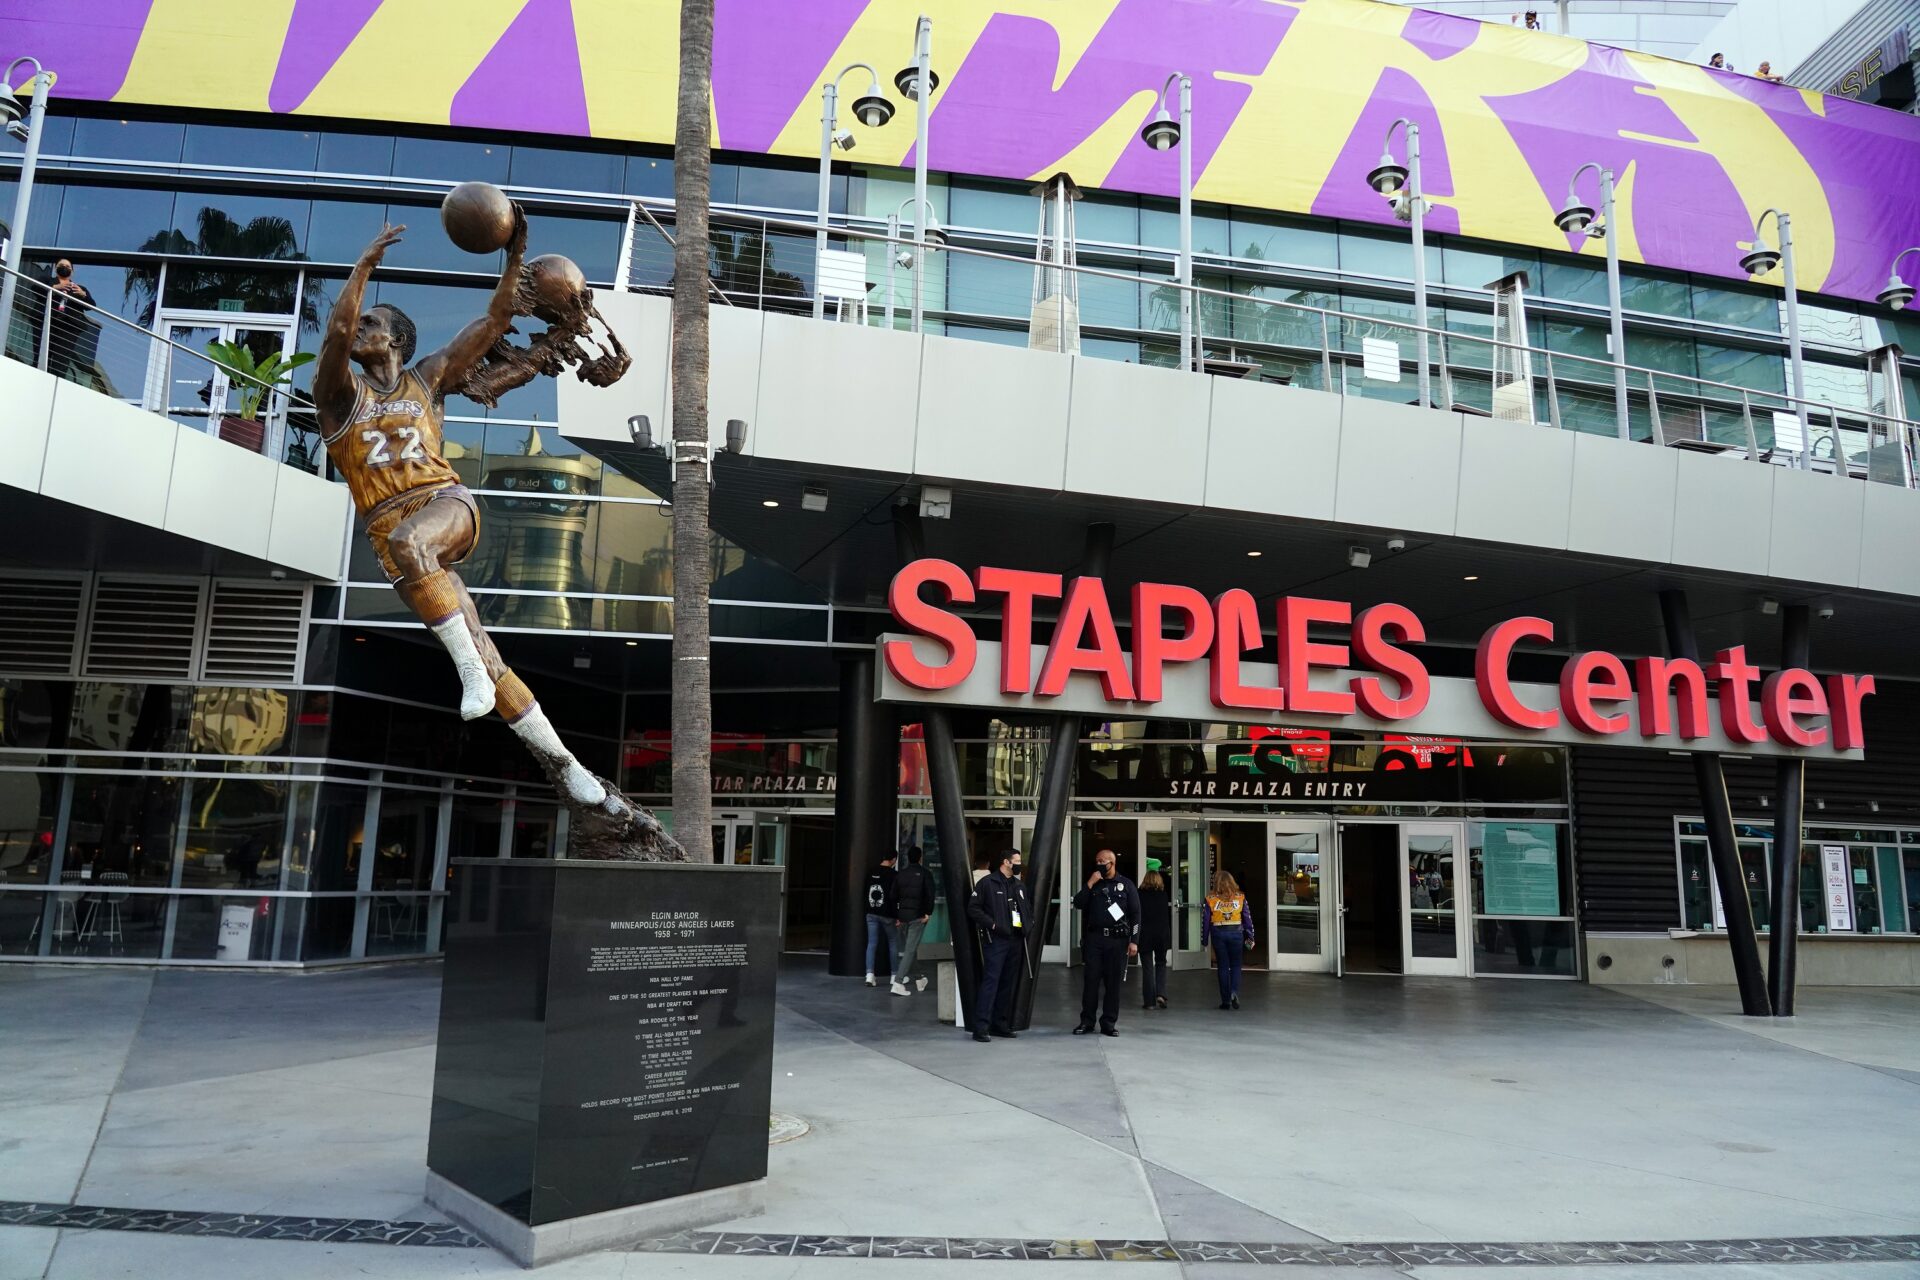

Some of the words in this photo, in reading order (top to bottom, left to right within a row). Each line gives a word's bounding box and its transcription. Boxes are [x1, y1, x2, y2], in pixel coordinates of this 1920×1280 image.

[1829, 47, 1884, 100] SE
[355, 398, 425, 424] LAKERS
[362, 427, 425, 465] 22
[883, 558, 1431, 720] STAPLES
[1475, 616, 1876, 750] Center
[712, 776, 745, 791] TAR
[752, 776, 806, 791] PLAZA
[816, 776, 837, 791] EN
[1170, 780, 1217, 795] STAR
[1229, 781, 1292, 796] PLAZA
[1304, 782, 1367, 797] ENTRY
[1744, 826, 1752, 836] 2
[1854, 830, 1861, 841] 4
[1907, 832, 1914, 843] 5
[1295, 864, 1319, 874] STAP
[651, 911, 671, 920] ELGIN
[674, 911, 700, 920] BAYLOR
[610, 920, 676, 930] MINNEAPOLIS/LOS
[678, 920, 708, 929] ANGELES
[710, 919, 736, 929] LAKERS
[654, 929, 671, 938] 1958
[680, 929, 696, 938] 1971
[649, 976, 660, 984] NBA
[660, 975, 672, 983] HALL
[672, 975, 681, 983] OF
[680, 974, 694, 982] FAME
[609, 993, 620, 1001] ONE
[621, 993, 629, 1001] OF
[629, 992, 639, 1000] THE
[648, 990, 671, 999] GREATEST
[672, 989, 692, 998] PLAYERS
[699, 988, 709, 996] NBA
[709, 987, 729, 996] HISTORY
[646, 1002, 657, 1010] NBA
[666, 1000, 682, 1009] DRAFT
[682, 999, 694, 1008] PICK
[638, 1017, 649, 1025] NBA
[686, 1013, 700, 1022] YEAR
[581, 1101, 599, 1110] HOLDS
[599, 1097, 621, 1107] RECORD
[621, 1095, 632, 1105] FOR
[632, 1094, 647, 1103] MOST
[648, 1091, 666, 1101] POINTS
[666, 1089, 686, 1099] SCORED
[633, 1110, 660, 1121] DEDICATED
